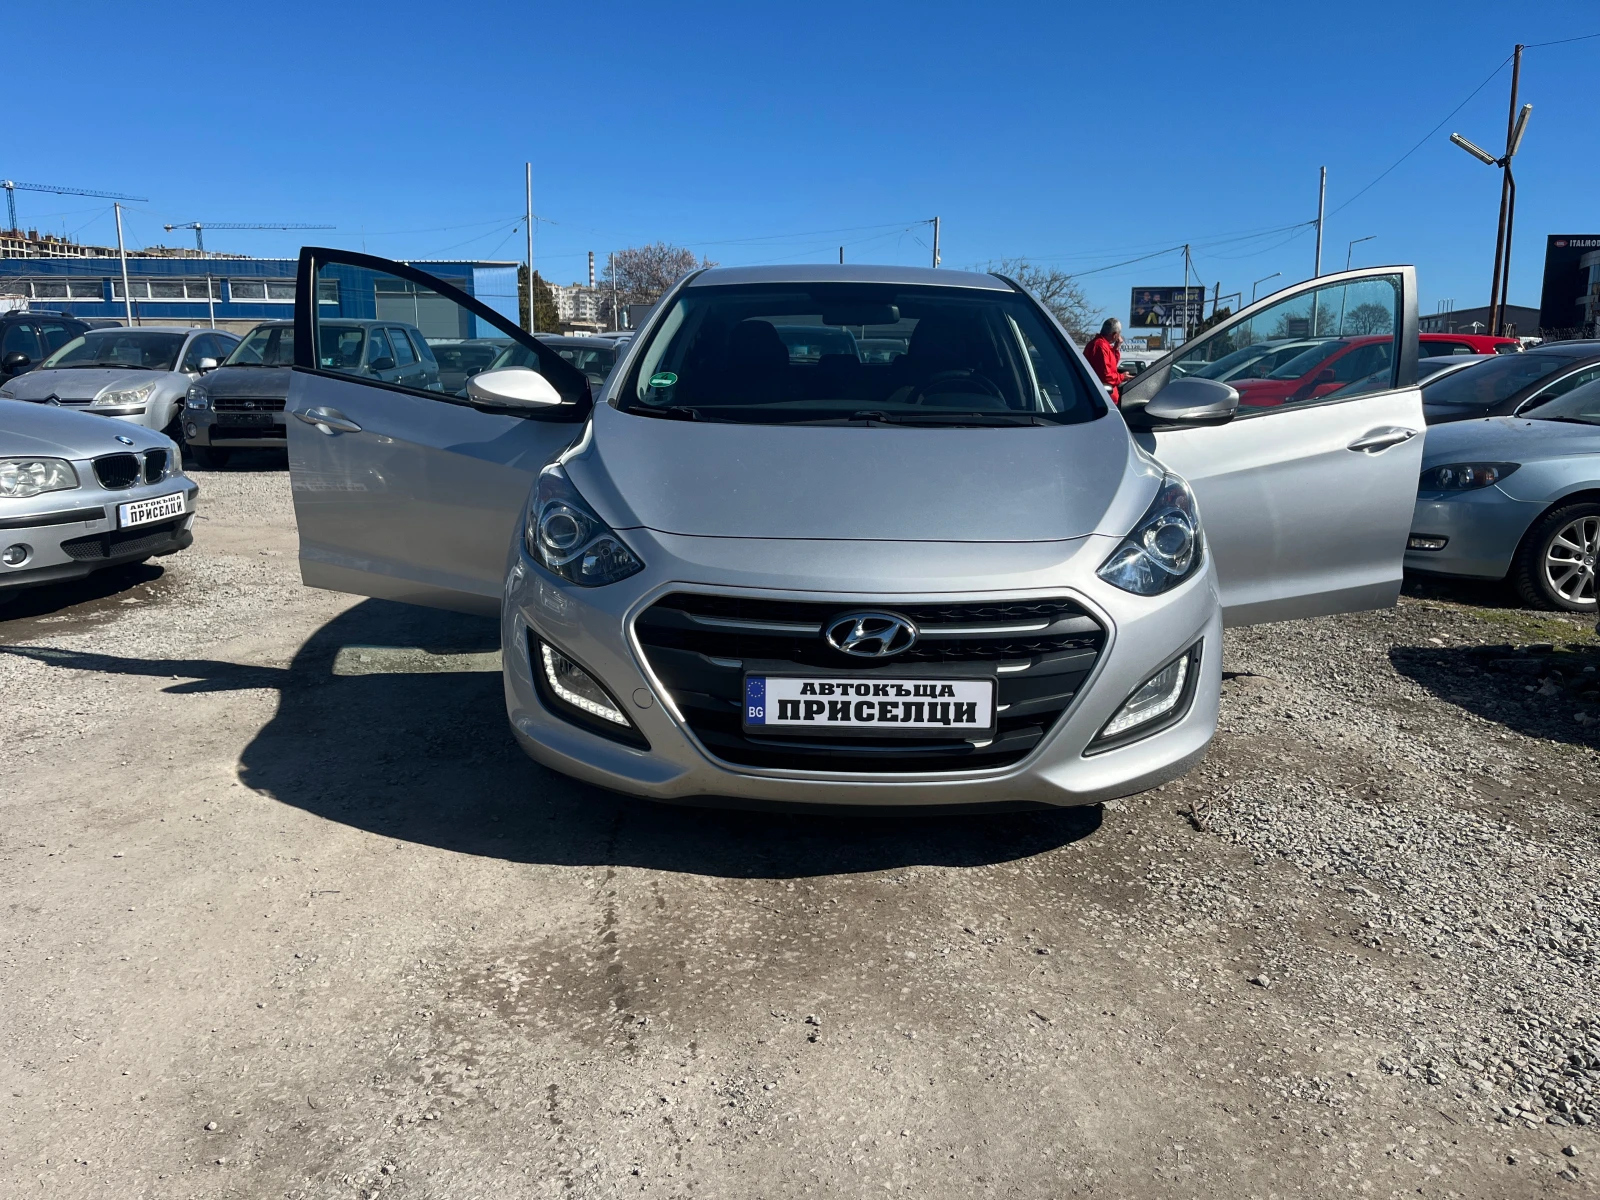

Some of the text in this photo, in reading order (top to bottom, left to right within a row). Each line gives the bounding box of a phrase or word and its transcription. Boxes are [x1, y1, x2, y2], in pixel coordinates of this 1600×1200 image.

[130, 495, 181, 511] АВТОКЪЩА
[130, 501, 183, 523] ПРИСЕЛЦИ
[800, 682, 955, 698] АВТОКЪЩА
[748, 706, 764, 718] BG
[777, 699, 977, 725] ПРИСЕЛЦИ
